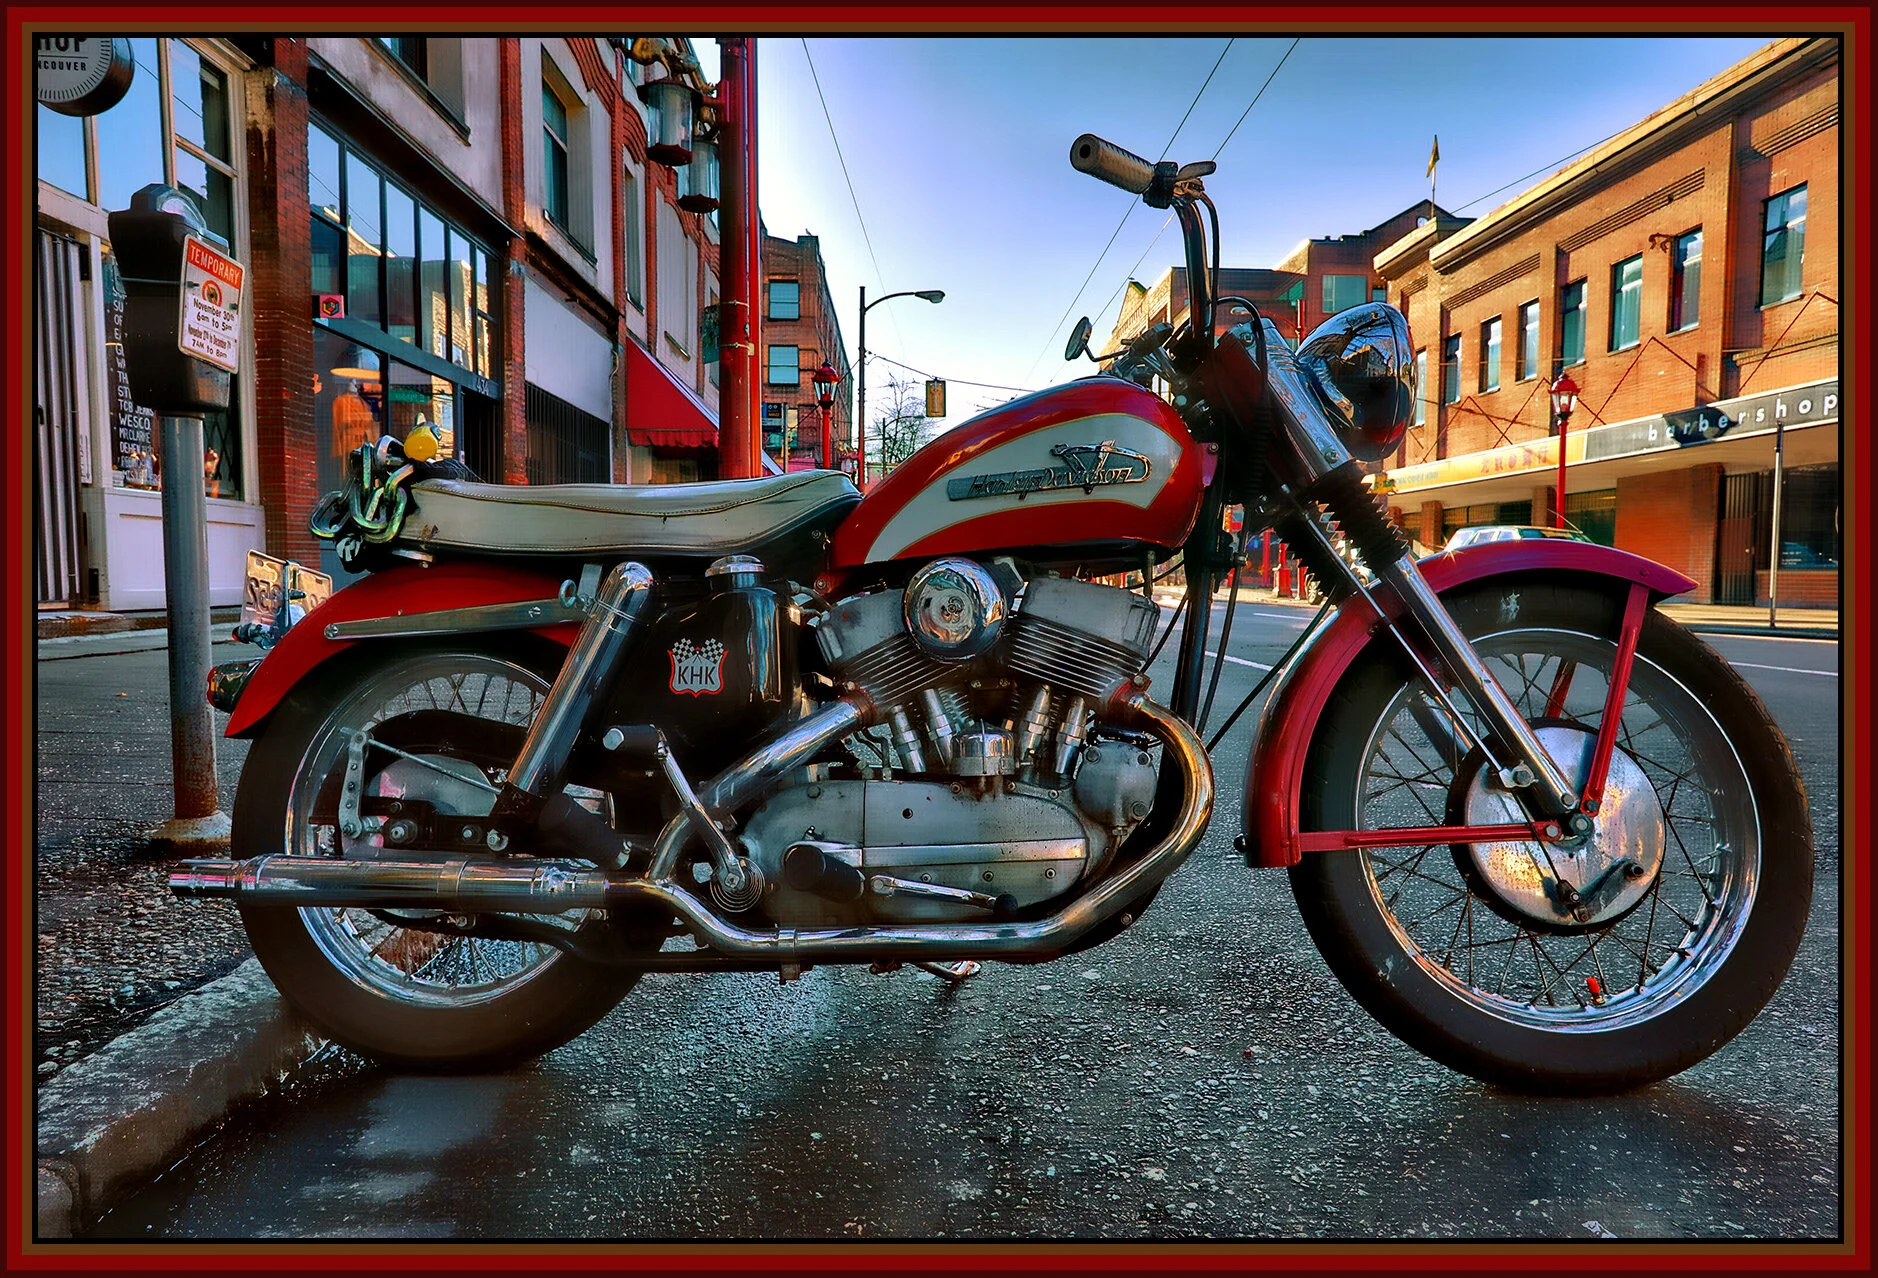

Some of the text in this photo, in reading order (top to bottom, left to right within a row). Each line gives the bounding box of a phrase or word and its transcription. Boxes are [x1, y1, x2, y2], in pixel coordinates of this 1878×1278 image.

[190, 245, 240, 285] TEMPORARY
[193, 298, 235, 322] November 30th
[196, 311, 232, 331] 6am to 5pm
[207, 345, 213, 354] to
[118, 399, 133, 412] TCB
[1648, 394, 1838, 441] barbershop
[678, 666, 716, 685] KHK
